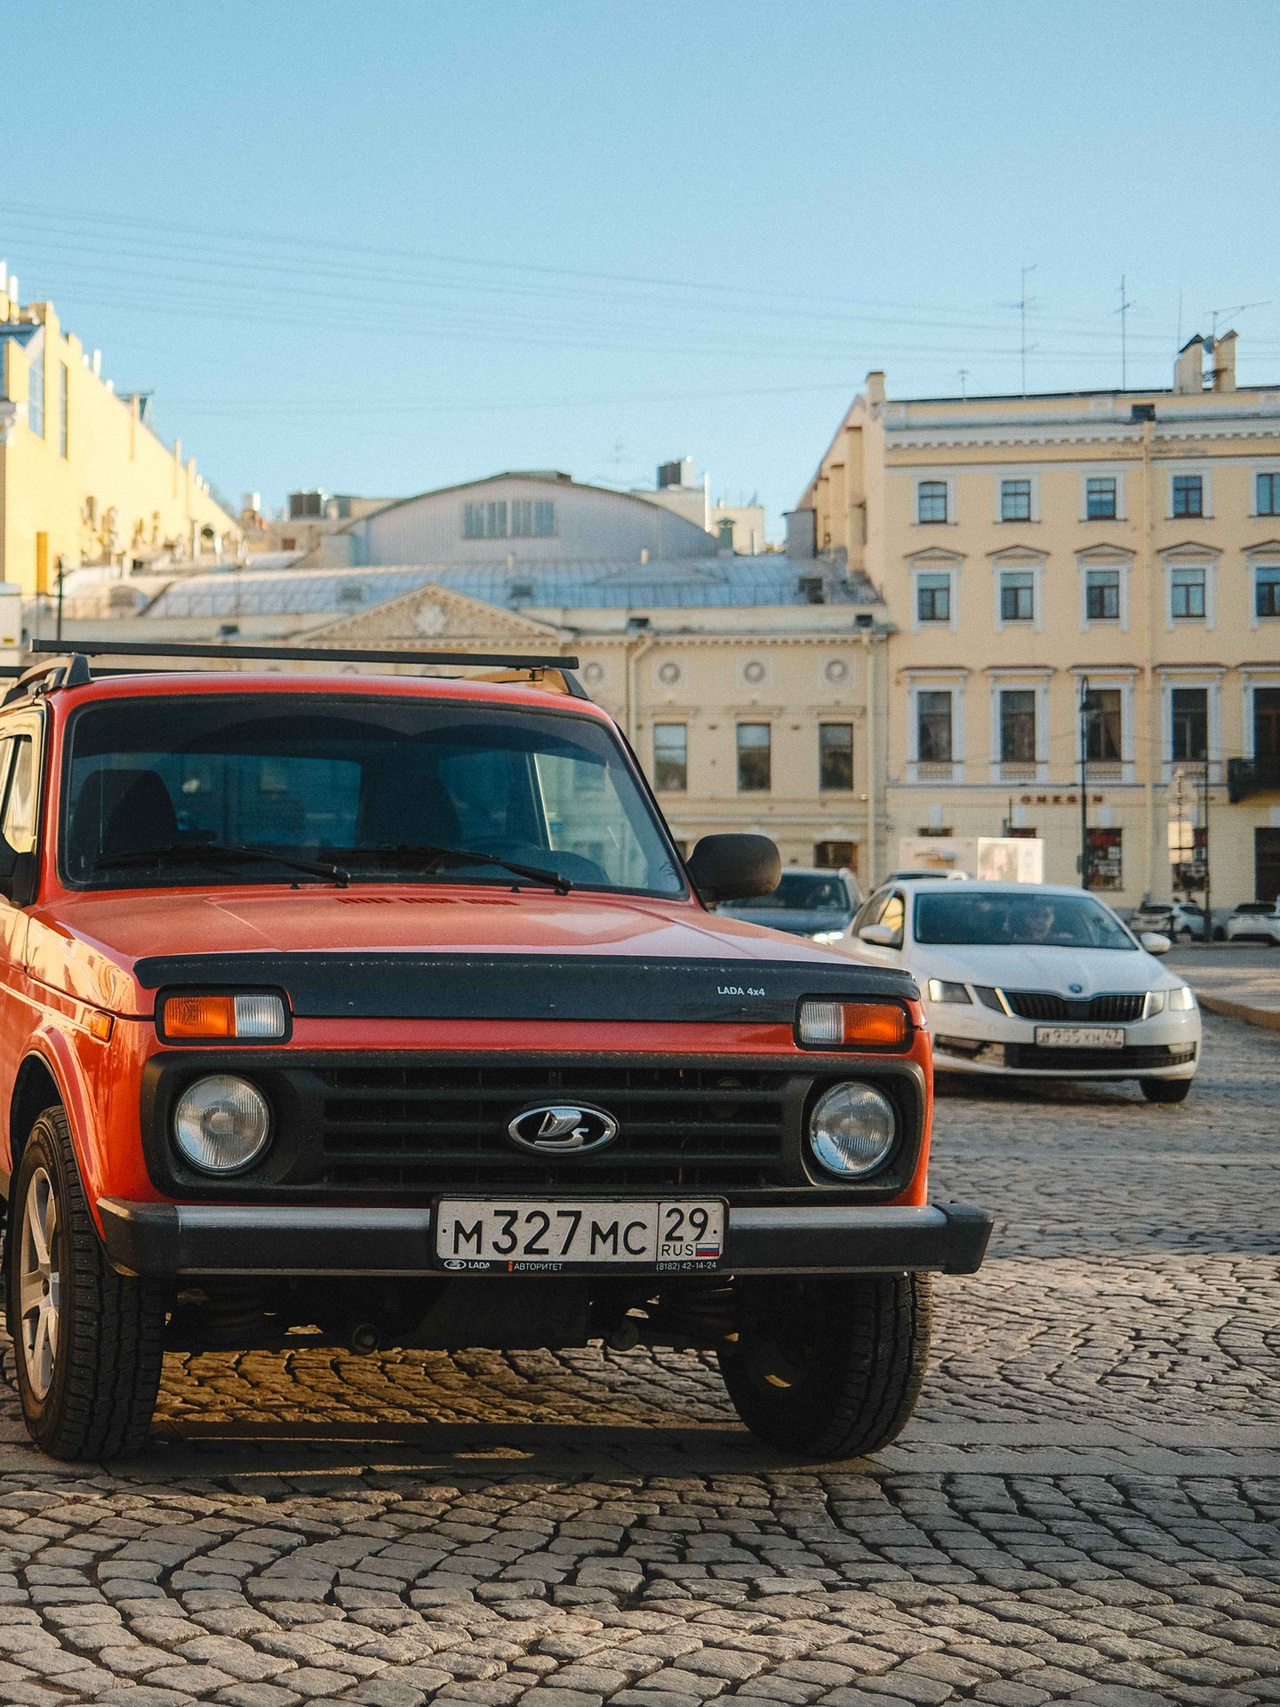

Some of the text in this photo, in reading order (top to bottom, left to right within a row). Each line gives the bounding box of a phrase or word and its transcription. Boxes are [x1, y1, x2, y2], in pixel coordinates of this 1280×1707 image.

[717, 986, 765, 996] LADA 4x4
[665, 1207, 709, 1241] 29
[661, 1244, 694, 1257] RUS
[468, 1261, 491, 1270] LADA
[513, 1262, 563, 1271] АВТОРИТЕТ
[656, 1261, 717, 1271] (8182) 42-14-24
